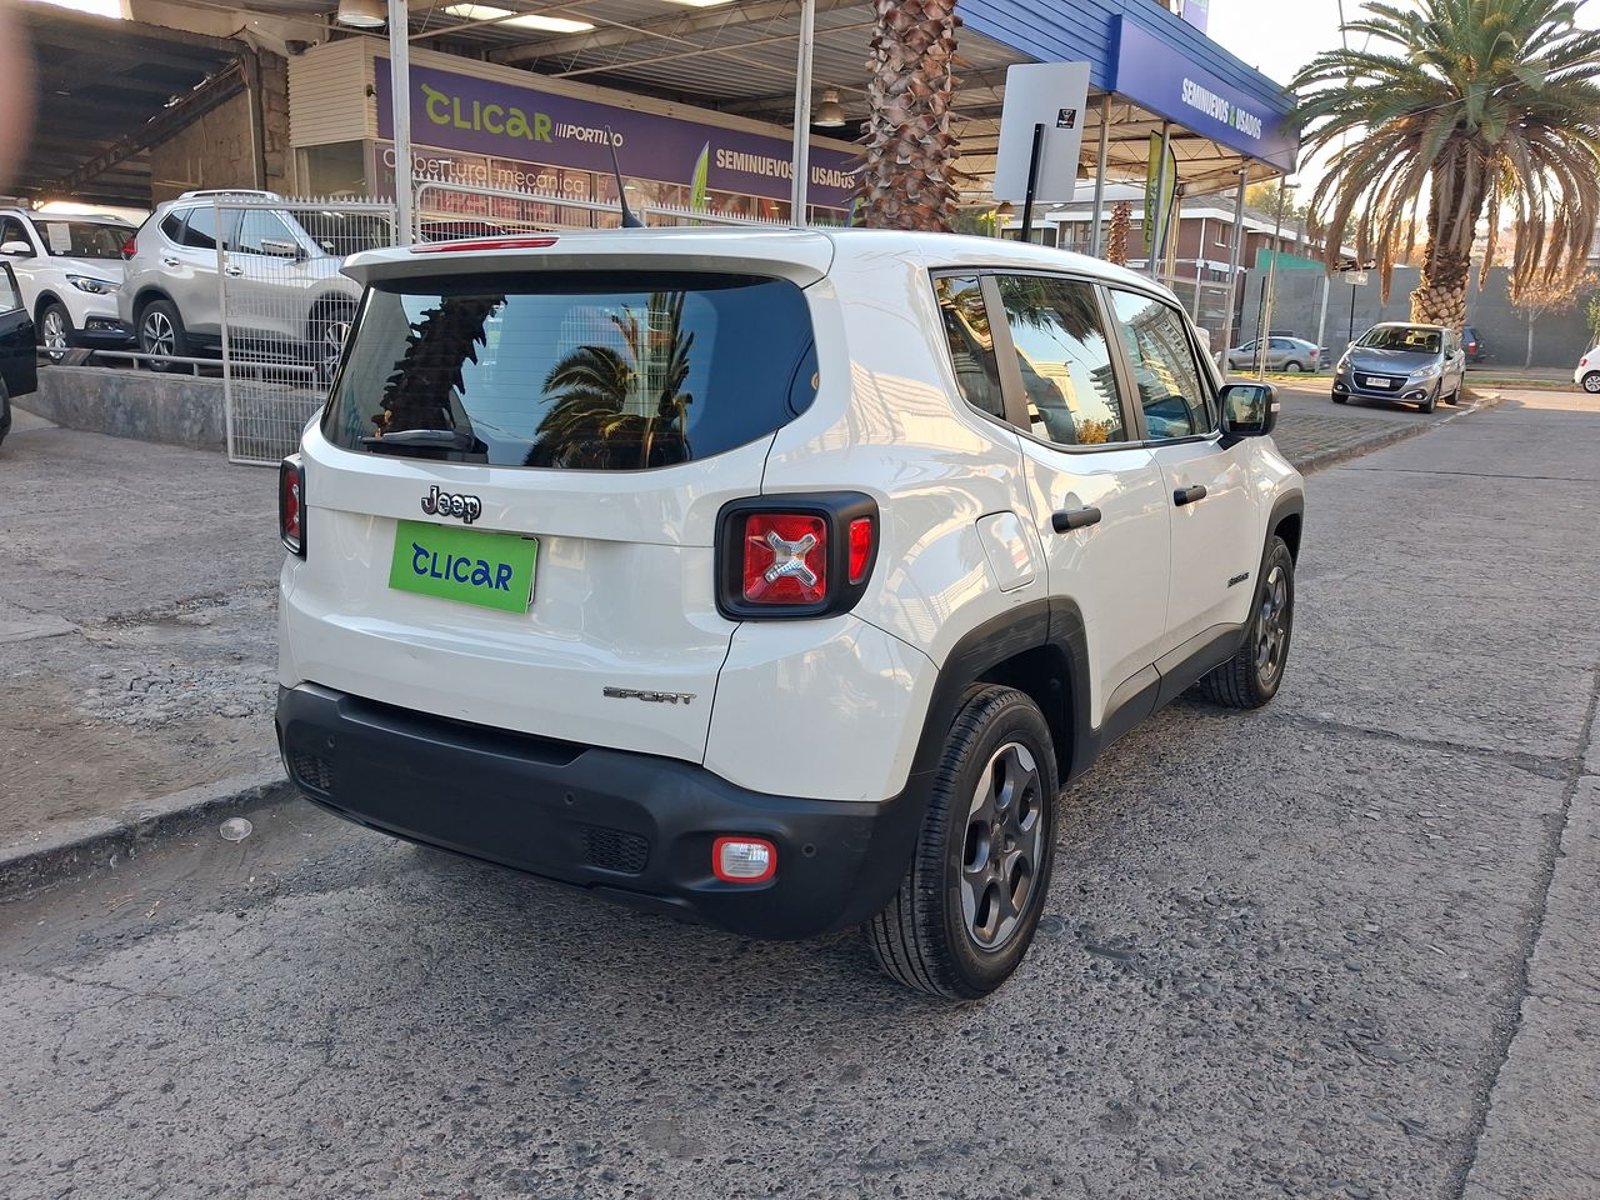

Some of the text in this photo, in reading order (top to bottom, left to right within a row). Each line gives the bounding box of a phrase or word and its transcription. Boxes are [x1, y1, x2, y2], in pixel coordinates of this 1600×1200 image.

[1181, 77, 1230, 124] SEMINUEVOS
[1235, 107, 1262, 140] USADOS
[383, 148, 487, 181] Cbertura
[497, 167, 585, 193] mecánica
[421, 485, 482, 524] Jeep
[603, 686, 697, 704] SPORT
